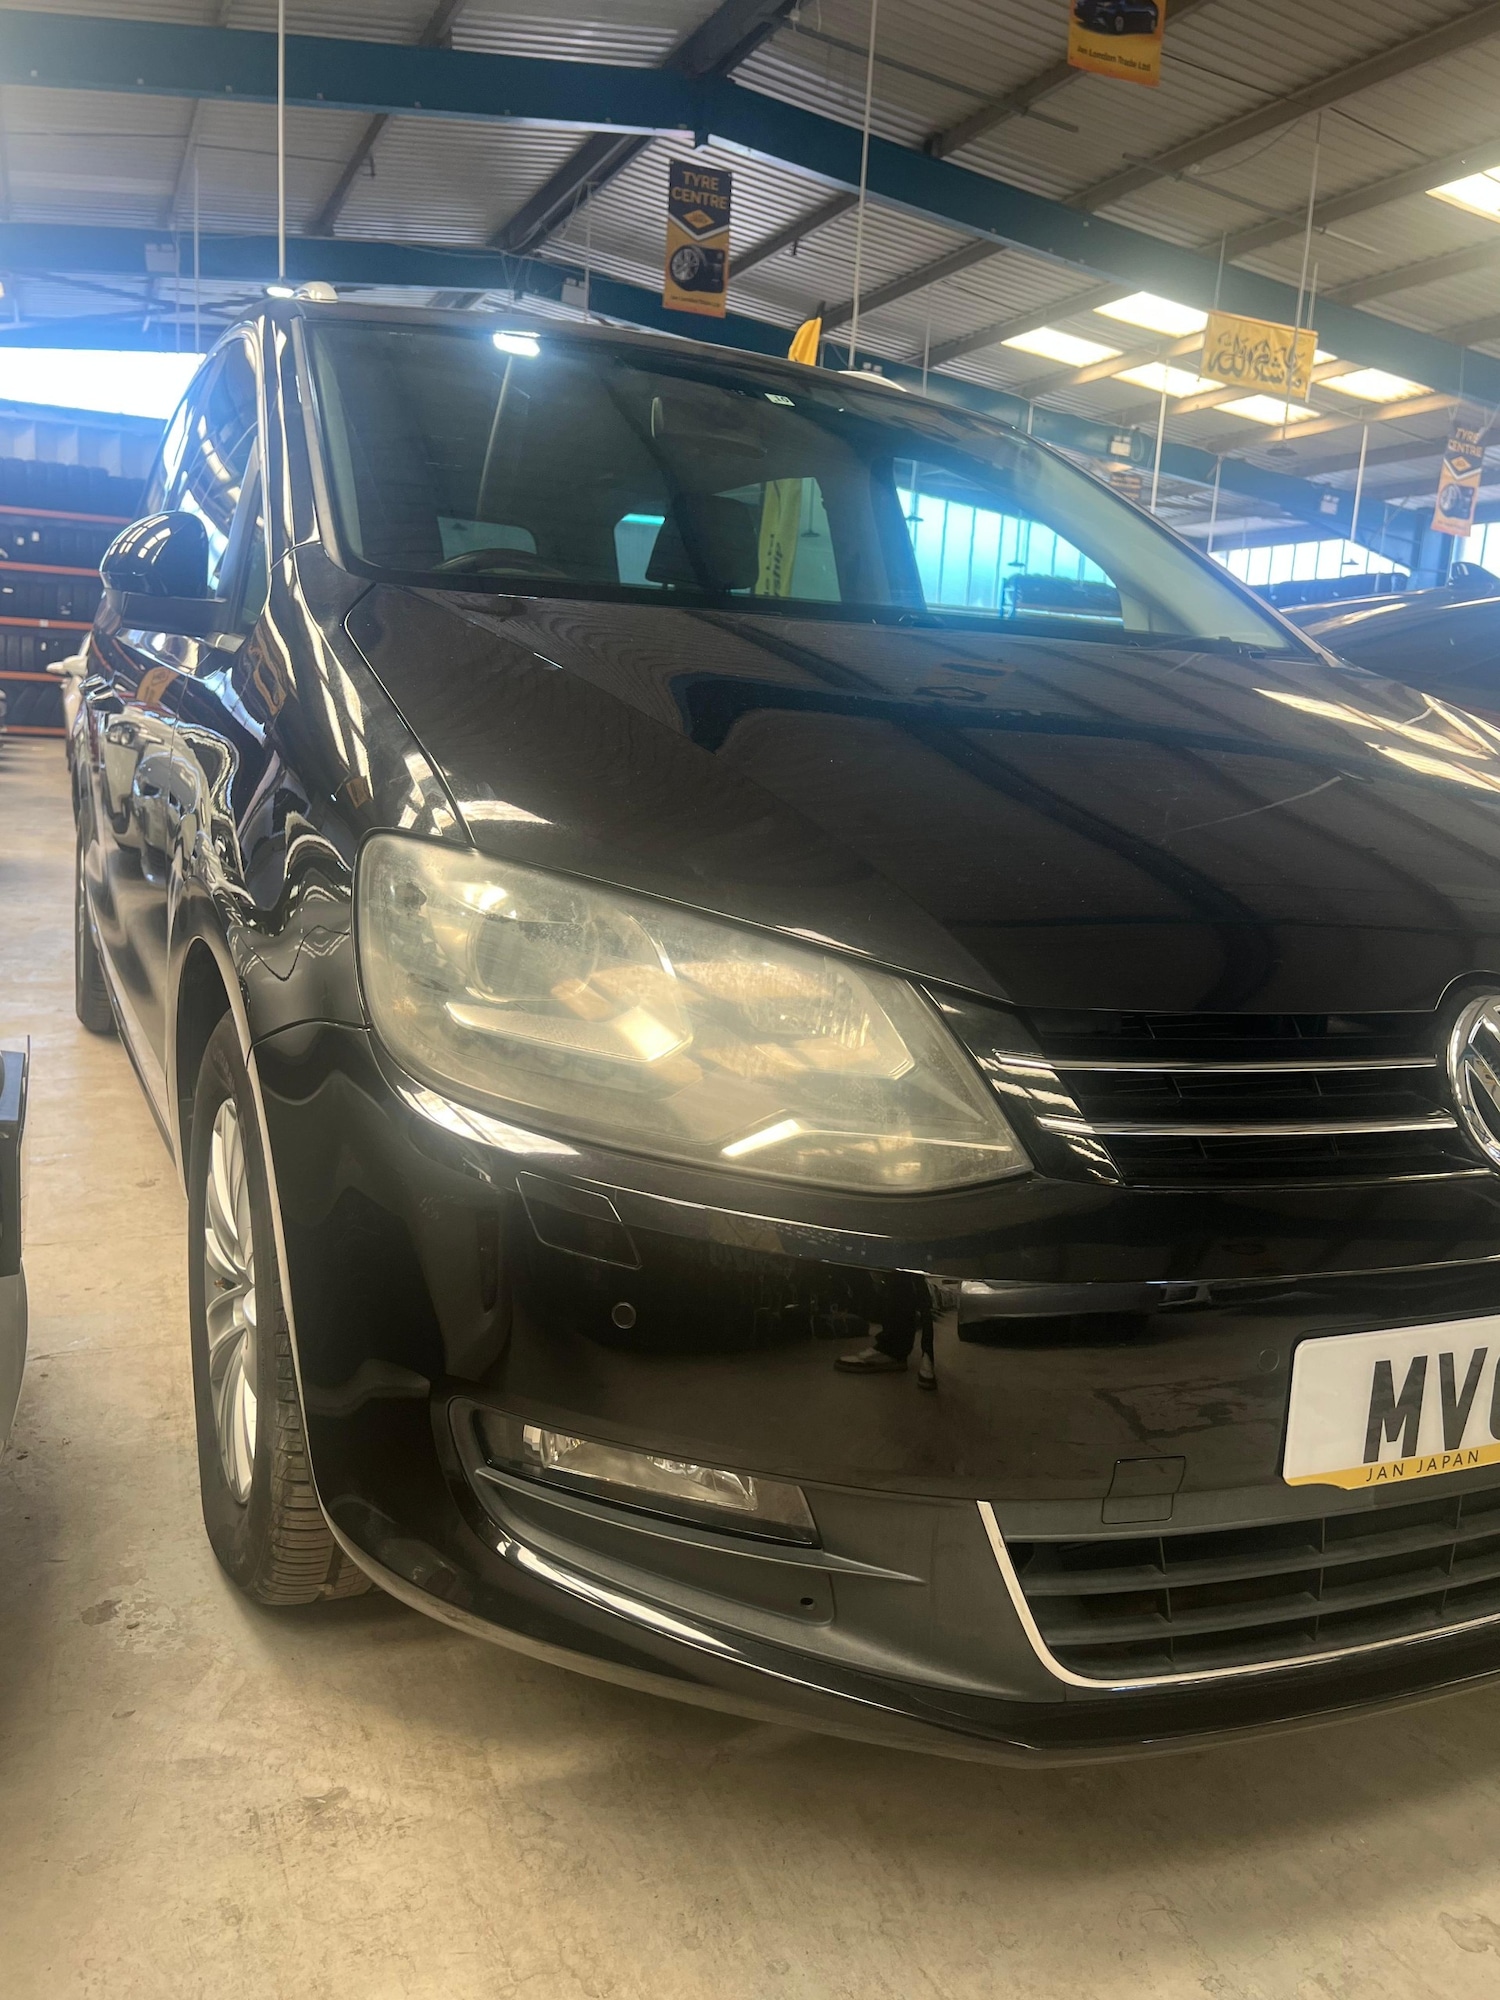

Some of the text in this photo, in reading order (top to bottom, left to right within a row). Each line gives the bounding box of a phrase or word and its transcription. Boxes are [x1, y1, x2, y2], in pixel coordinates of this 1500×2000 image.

[682, 171, 719, 190] TYRE
[671, 187, 728, 209] CENTRE
[1456, 427, 1480, 444] TYRE
[1448, 439, 1483, 457] CENTRE
[1363, 1346, 1500, 1464] MV
[1366, 1450, 1479, 1482] JAN JAPAN
